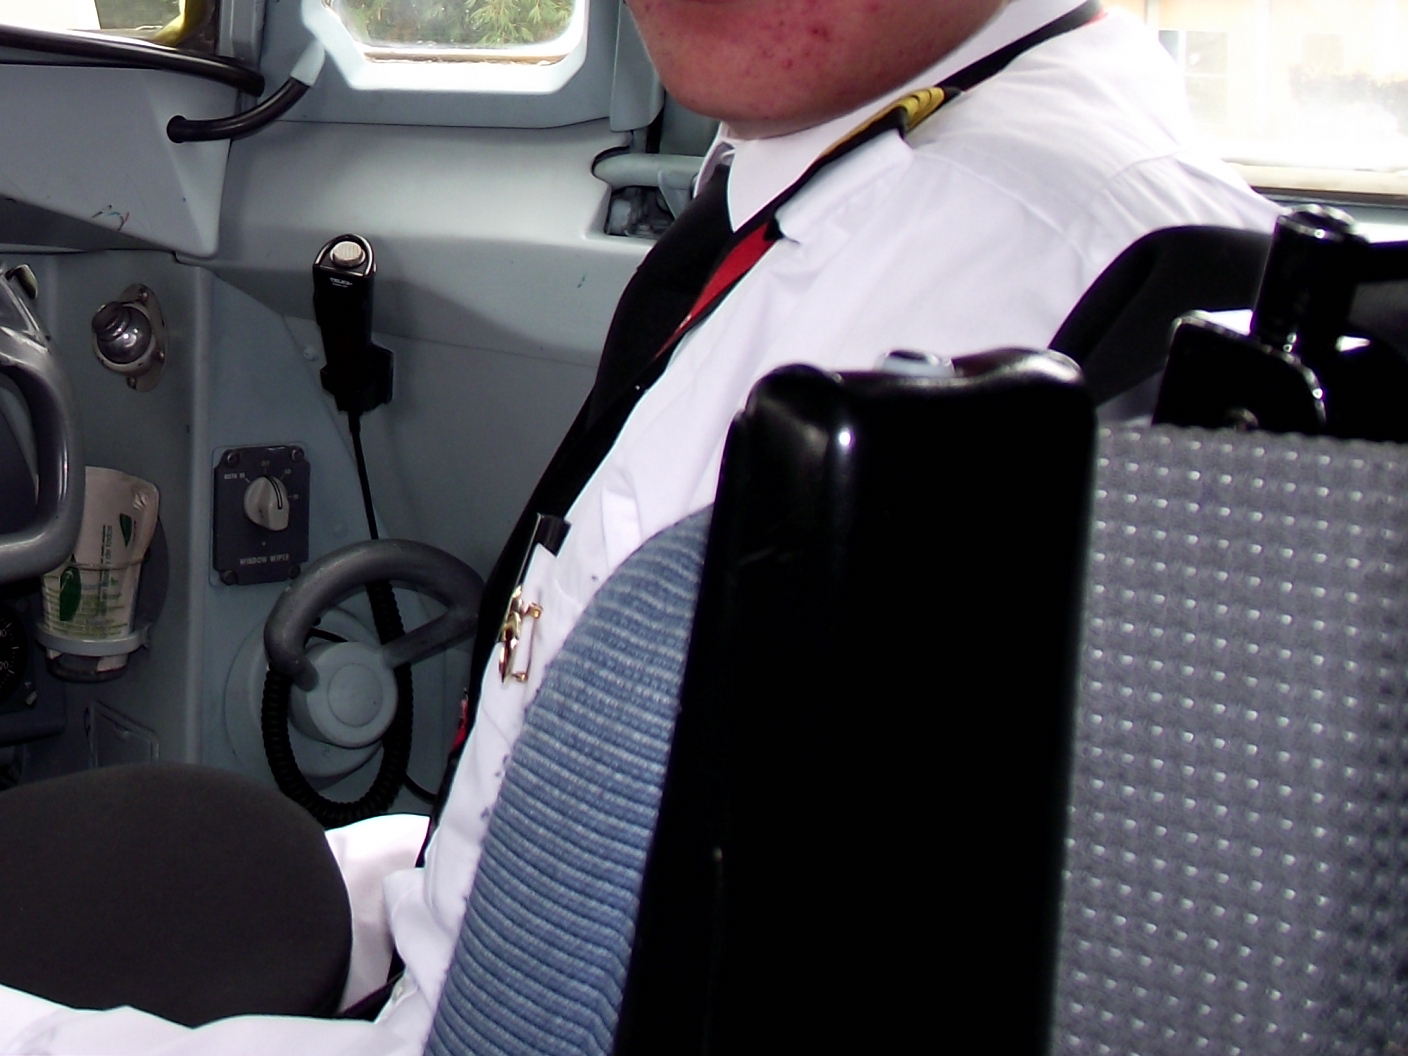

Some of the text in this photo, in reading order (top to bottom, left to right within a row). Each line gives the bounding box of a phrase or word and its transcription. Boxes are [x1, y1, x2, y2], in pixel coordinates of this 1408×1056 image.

[104, 525, 112, 548] todos
[105, 549, 112, 560] de
[239, 553, 290, 566] WINDOW WIPER
